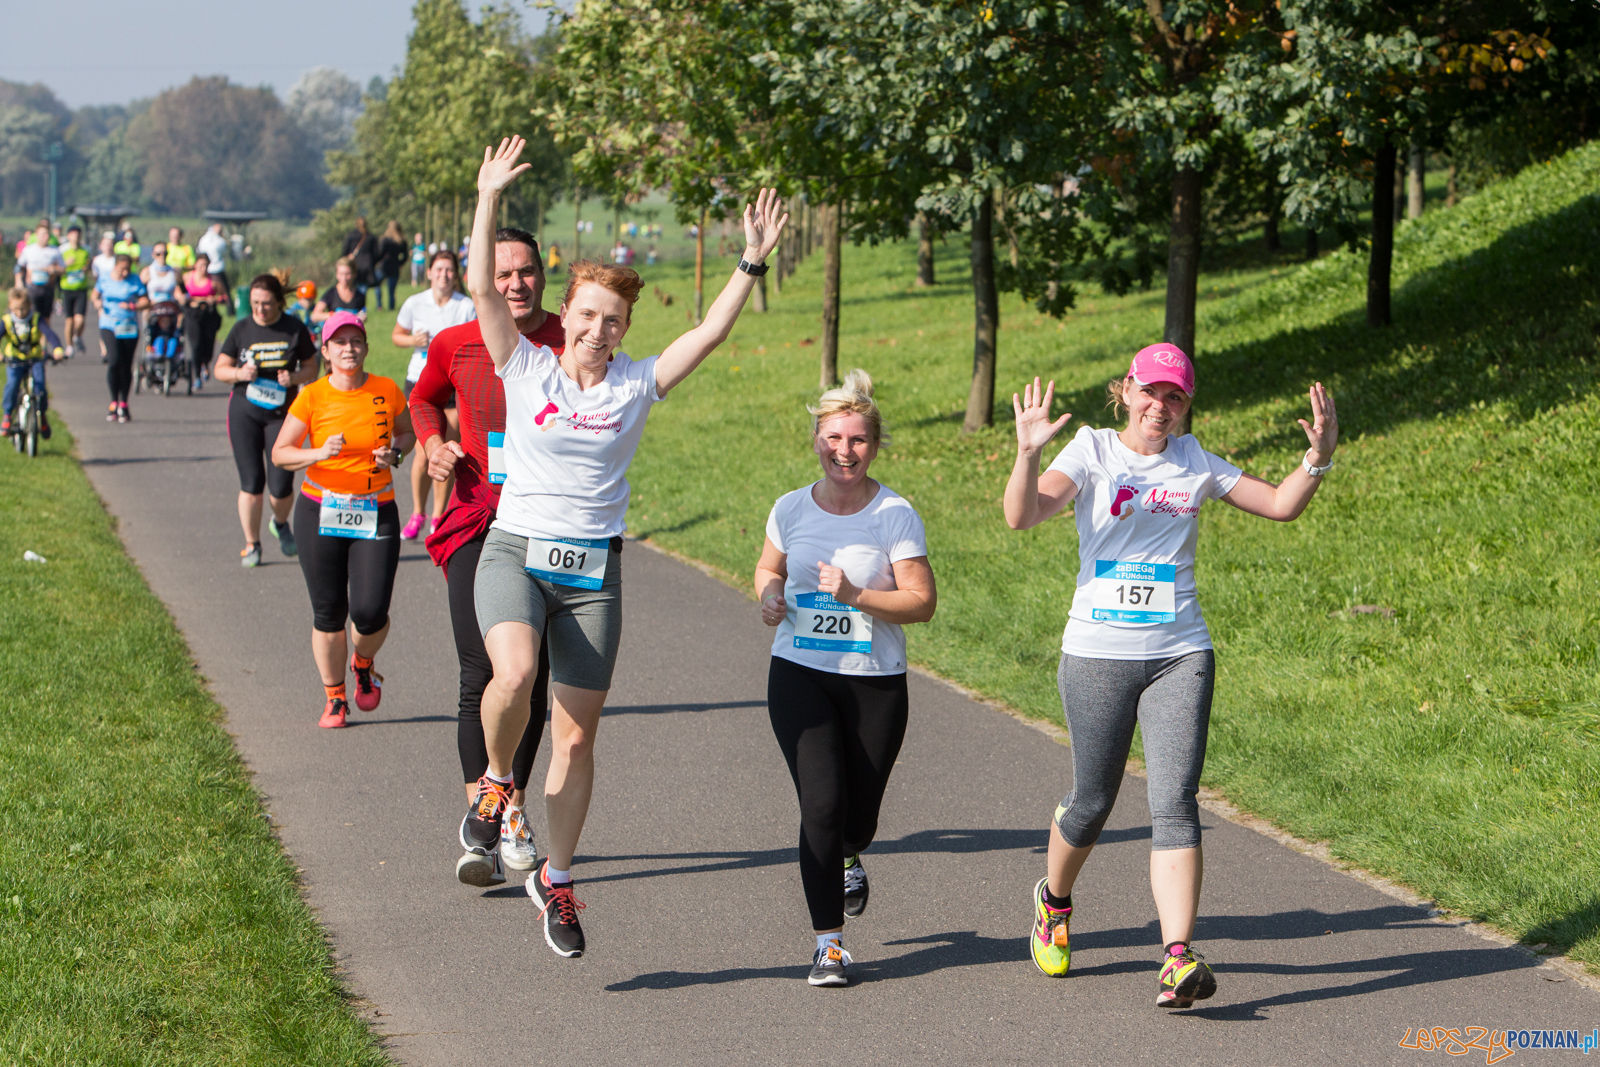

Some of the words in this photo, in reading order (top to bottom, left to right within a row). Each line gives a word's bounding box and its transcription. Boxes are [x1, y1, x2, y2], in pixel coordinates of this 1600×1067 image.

[1153, 351, 1186, 369] Run
[373, 396, 389, 439] CITY
[1144, 488, 1190, 502] Mamy
[336, 512, 363, 526] 120
[548, 547, 587, 570] 061
[1115, 563, 1156, 575] zaBIEGaj
[1121, 572, 1155, 580] FUNdusze
[1116, 584, 1155, 605] 157
[812, 614, 851, 635] 220
[483, 799, 496, 815] 061
